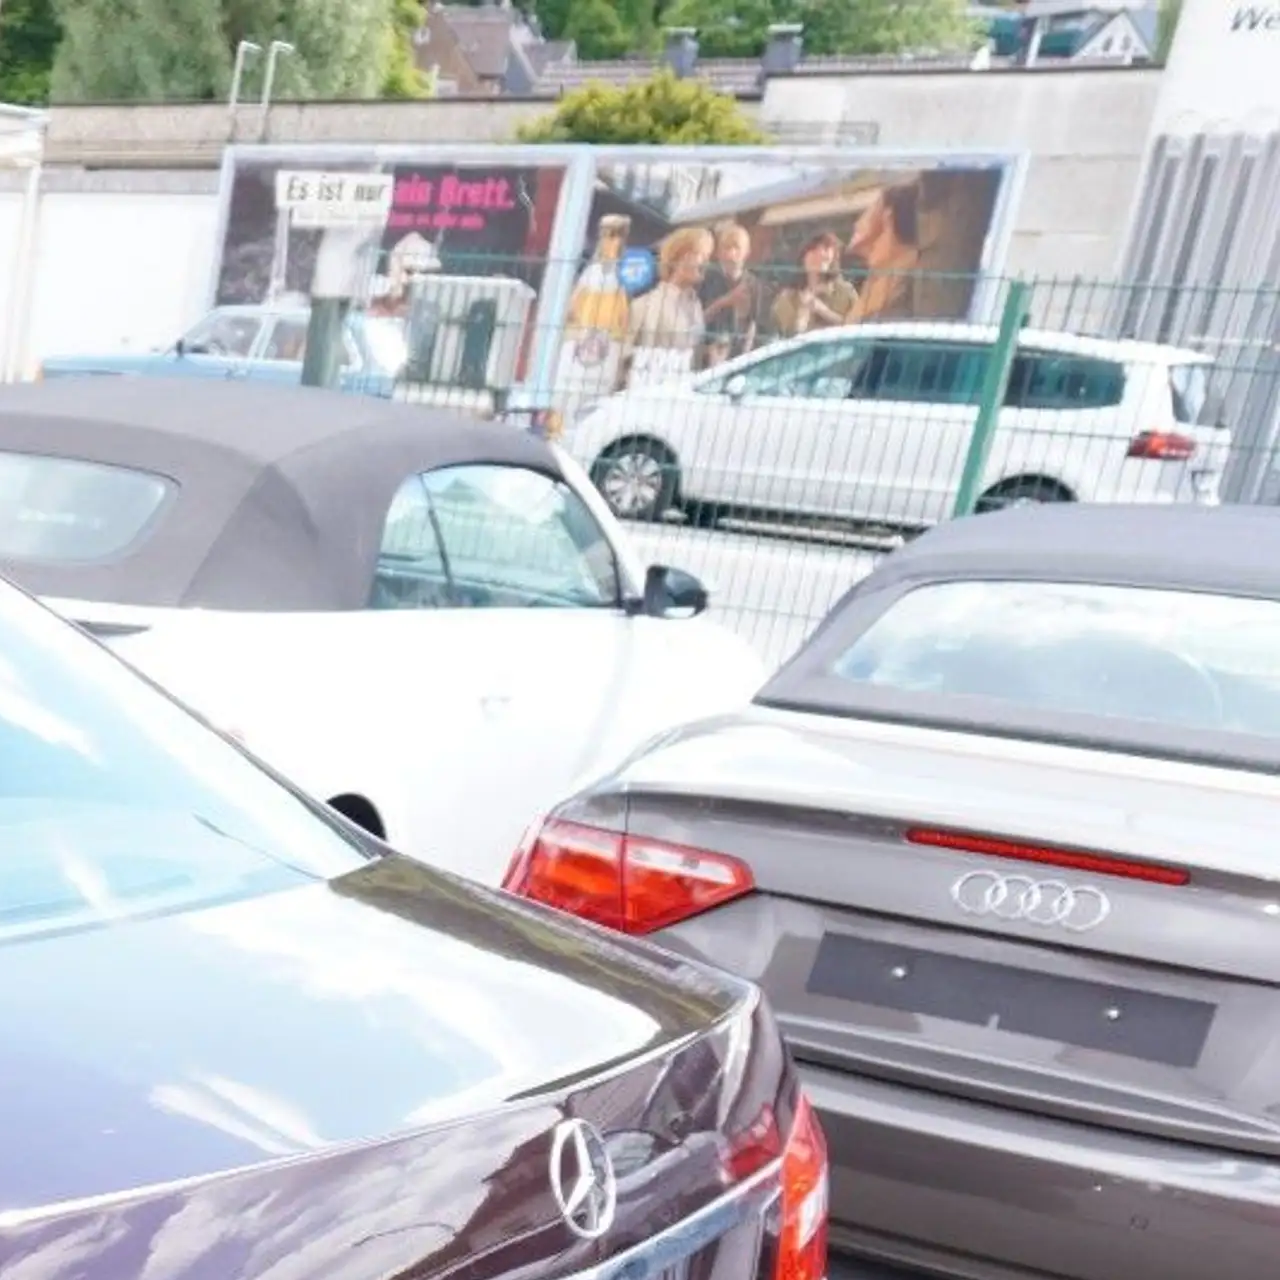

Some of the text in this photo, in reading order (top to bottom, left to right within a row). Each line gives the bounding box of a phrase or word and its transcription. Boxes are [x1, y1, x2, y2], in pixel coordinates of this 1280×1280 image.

[287, 175, 309, 202] Es
[318, 174, 345, 202] ist
[354, 183, 388, 202] nur
[440, 175, 516, 209] Brett.
